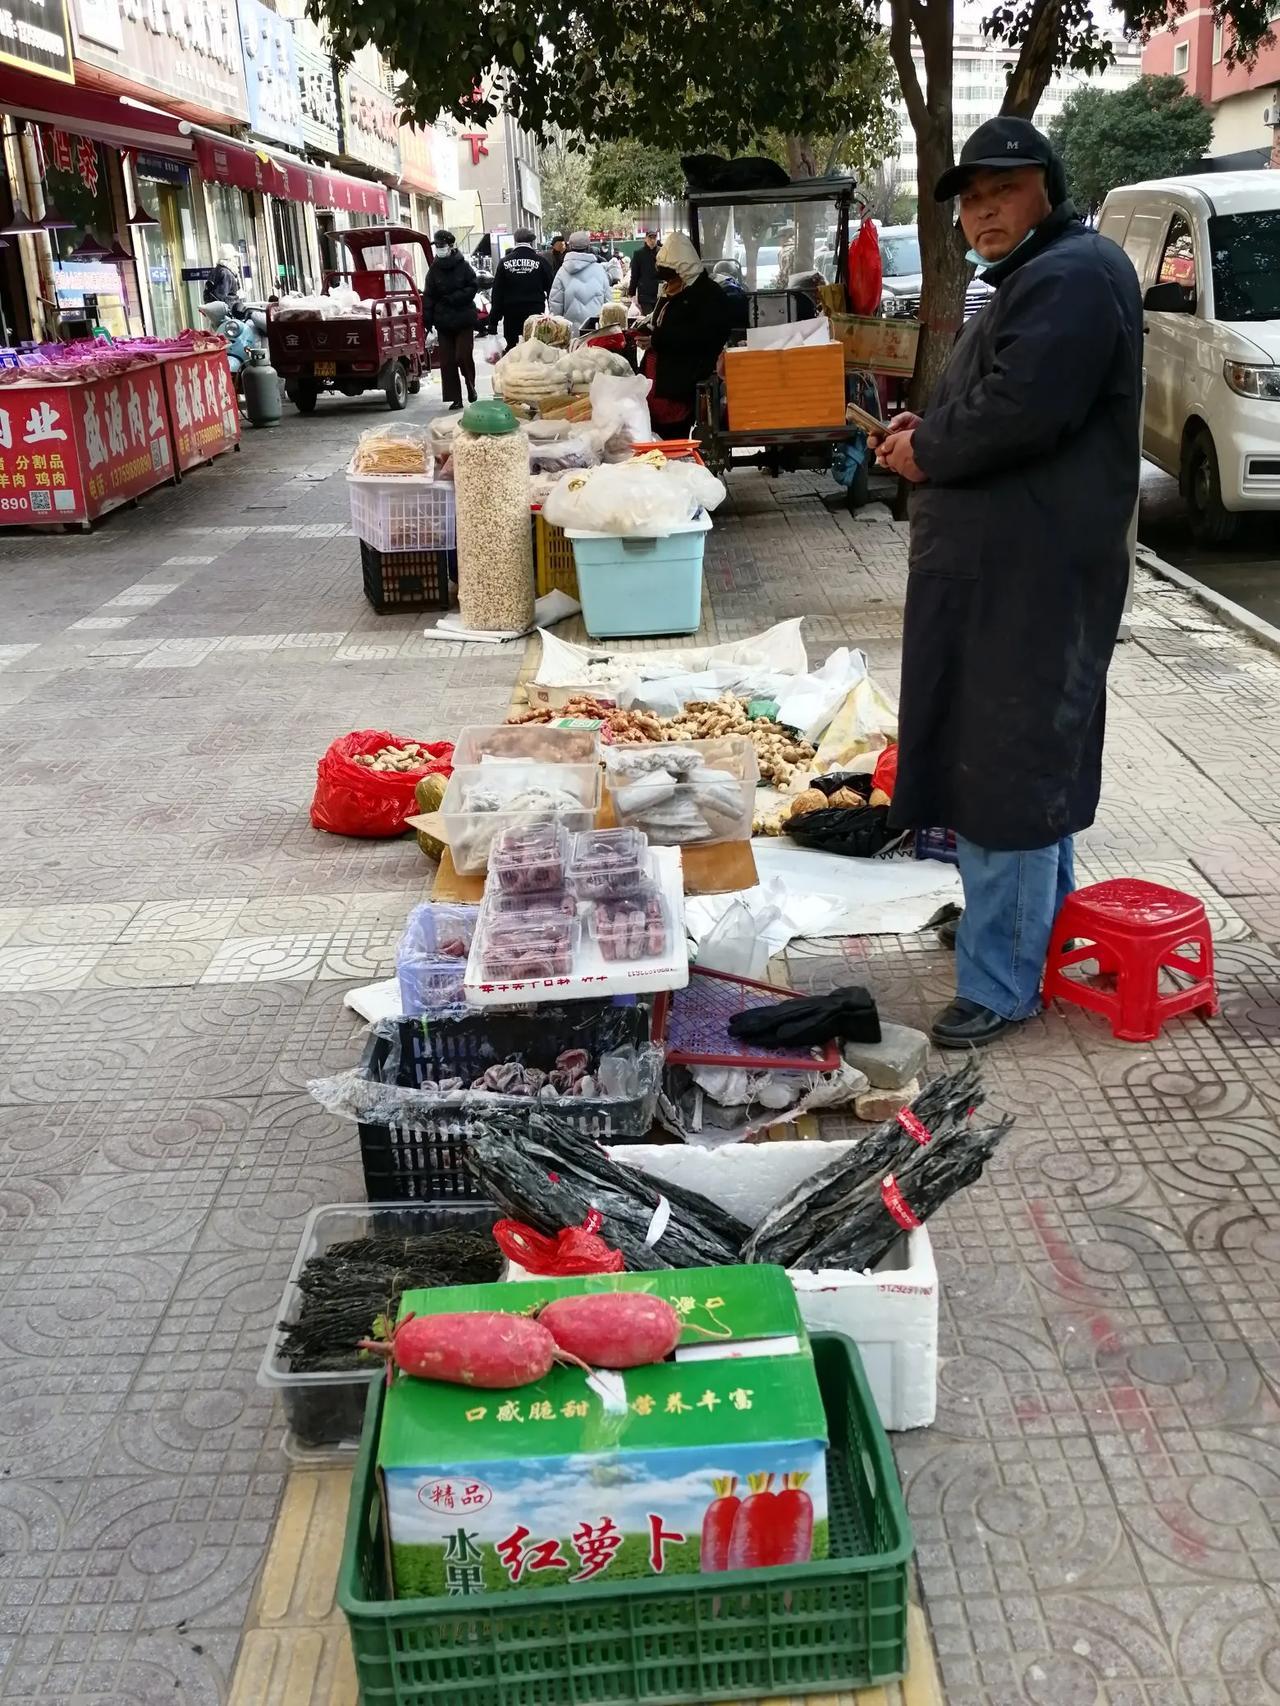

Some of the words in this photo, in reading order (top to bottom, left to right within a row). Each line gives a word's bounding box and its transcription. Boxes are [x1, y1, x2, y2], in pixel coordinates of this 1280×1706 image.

[1006, 141, 1018, 150] M
[503, 258, 540, 271] SKECHERS
[285, 334, 299, 346] 金
[346, 332, 360, 345] 元
[16, 454, 65, 471] 分割品
[35, 471, 66, 487] 鸡肉
[1, 497, 28, 511] 890
[465, 1400, 590, 1423] 口感脆甜
[631, 1387, 754, 1416] 营养丰富
[429, 1484, 485, 1509] 精品
[496, 1512, 688, 1582] 红萝卜
[442, 1527, 486, 1597] 水果
